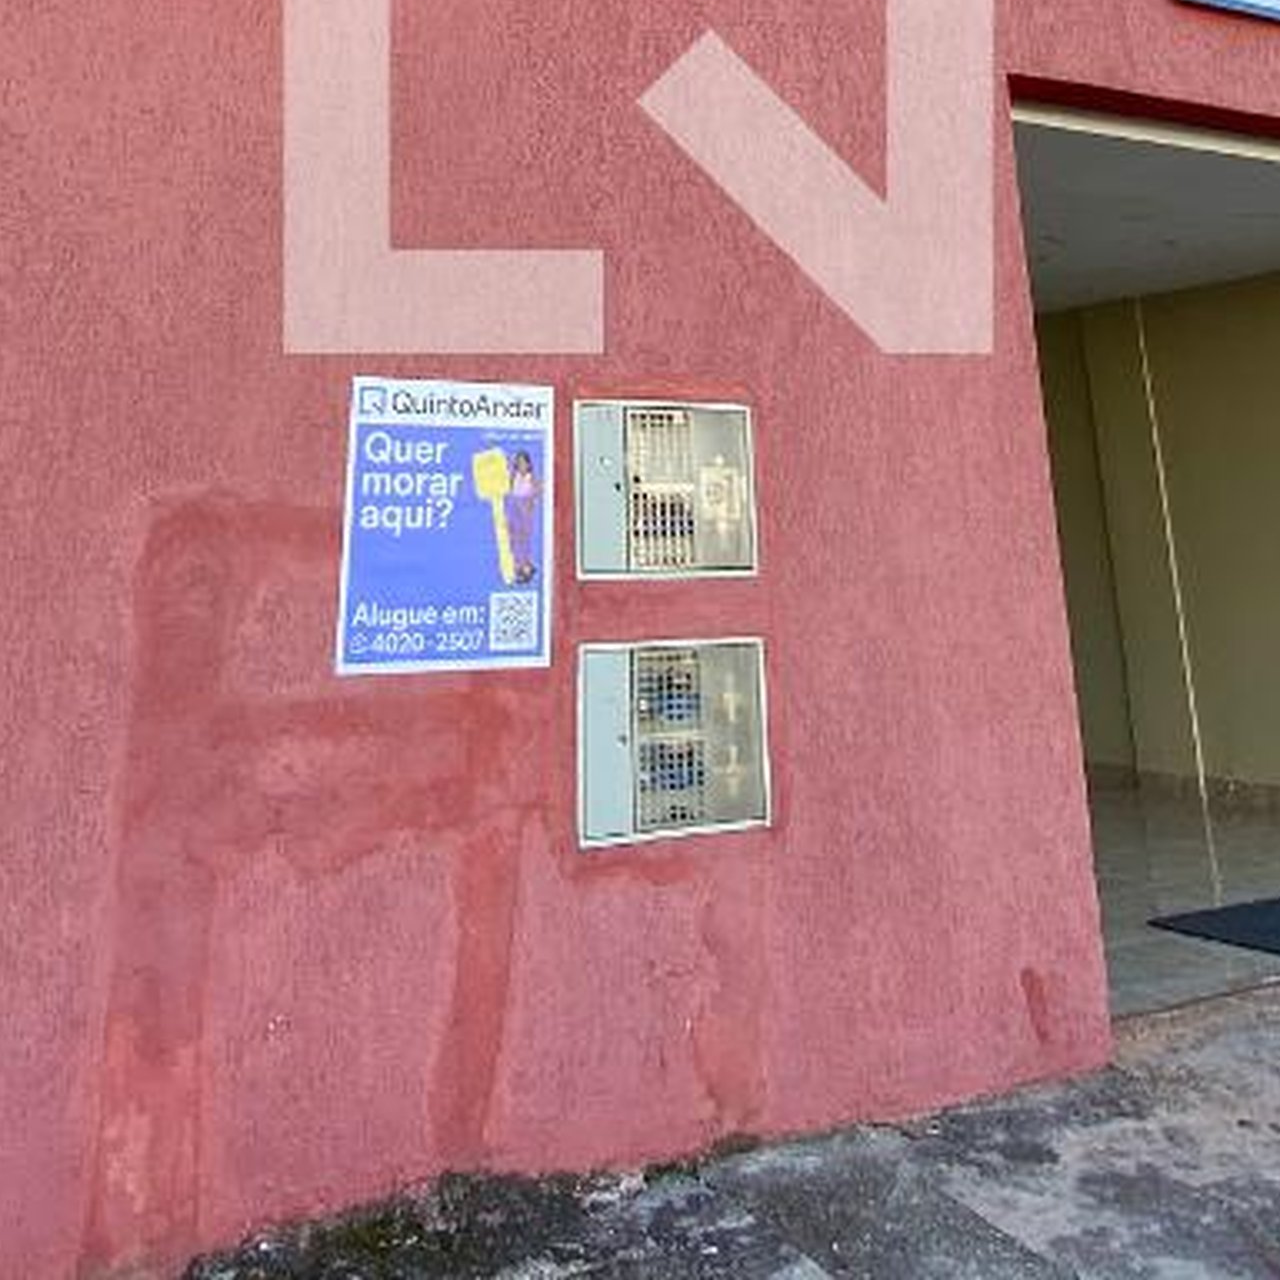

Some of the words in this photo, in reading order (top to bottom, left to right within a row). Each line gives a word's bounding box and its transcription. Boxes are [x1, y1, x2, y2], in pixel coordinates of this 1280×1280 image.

[392, 390, 548, 419] QuintoAndar
[364, 430, 449, 464] Quer
[361, 471, 464, 497] morar
[358, 498, 454, 538] aqui?
[351, 601, 439, 632] Alugue
[441, 604, 486, 625] em:
